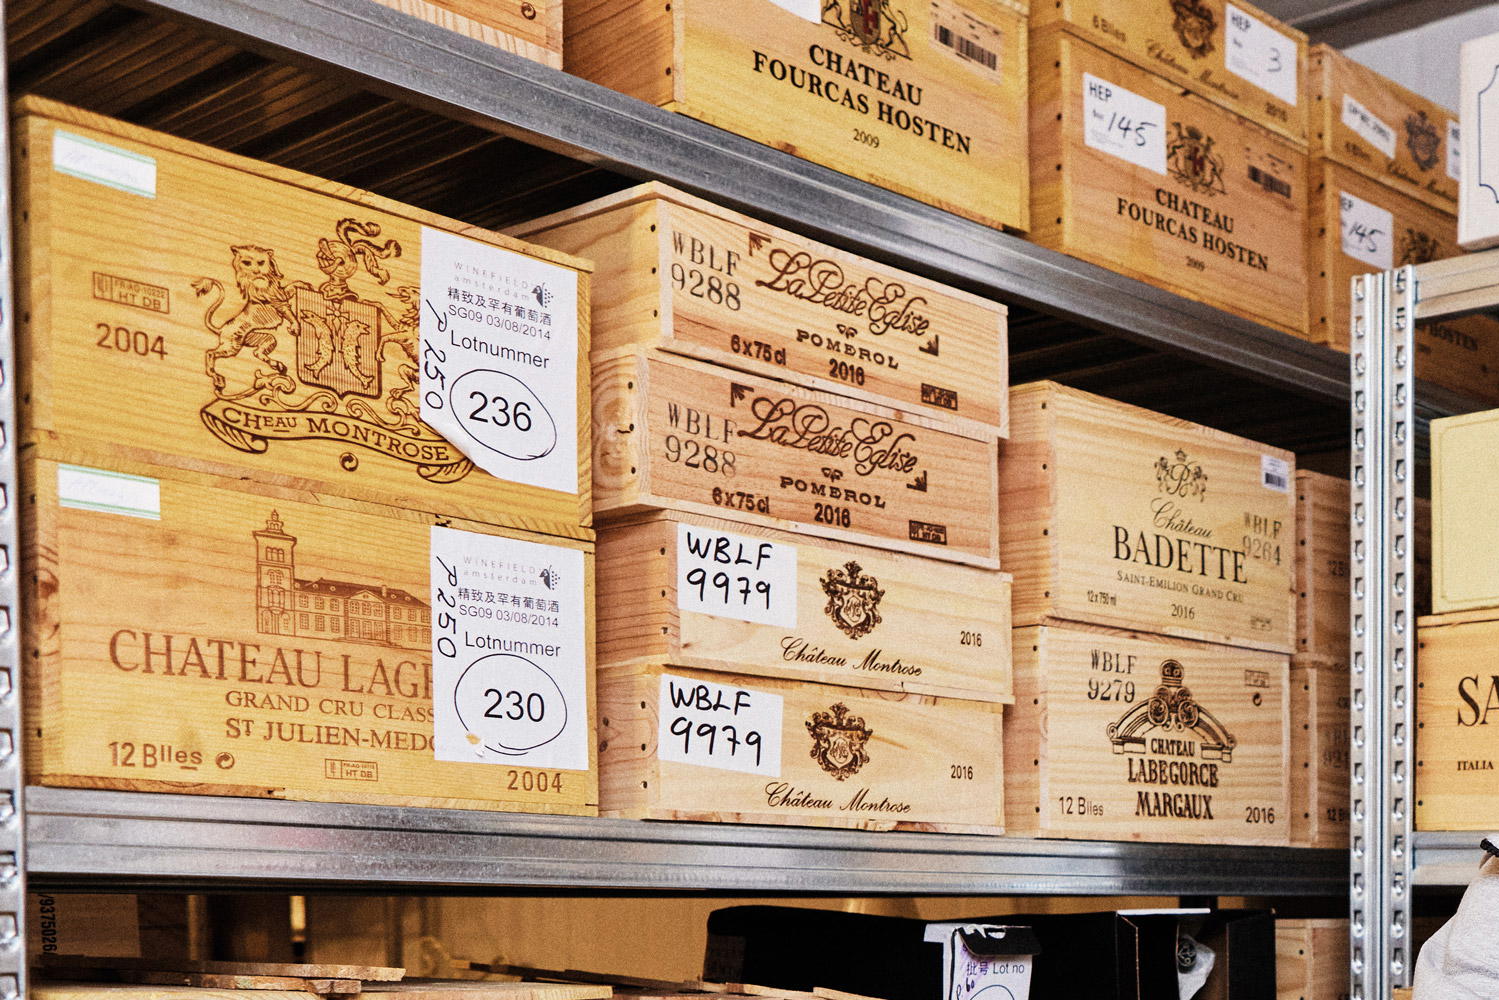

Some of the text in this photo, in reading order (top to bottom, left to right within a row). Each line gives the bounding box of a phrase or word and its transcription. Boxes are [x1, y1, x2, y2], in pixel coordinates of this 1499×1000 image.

[809, 43, 923, 107] CHATEAU
[752, 49, 972, 155] FOURCAS HOSTEN
[1089, 82, 1113, 104] HEP
[853, 128, 880, 149] 2009
[1107, 111, 1158, 148] 145
[1155, 188, 1235, 234] CHATEAU
[1116, 197, 1270, 272] FOURCAS HOSTEN
[672, 231, 742, 277] WBLF
[671, 262, 743, 312] 9288
[448, 304, 551, 342] SG09 03/08/2014
[96, 323, 168, 361] 2004
[450, 329, 550, 369] Lotnummer
[795, 328, 899, 370] POMEROL
[829, 359, 866, 386] 2016
[469, 391, 533, 432] 236
[668, 401, 738, 439] WBLF
[306, 416, 450, 462] MONTROSE
[664, 434, 738, 478] 9288
[779, 475, 887, 509] POMEROL
[814, 503, 851, 528] 2016
[1151, 497, 1213, 538] Château
[687, 530, 773, 571] WBLF
[1113, 524, 1248, 585] BADETTE
[686, 568, 771, 610] 9979
[459, 604, 560, 629] SG09 03/08/2014
[1171, 603, 1196, 620] 2016
[464, 631, 562, 658] Lotnummer
[780, 635, 923, 676] Château Montrose
[960, 631, 983, 648] 2016
[109, 628, 323, 688] CHATEAU
[1090, 648, 1138, 675] WBLF
[225, 690, 364, 718] GRAND CRU
[483, 687, 546, 722] 230
[669, 681, 752, 712] WBLF
[1087, 678, 1137, 704] 9279
[109, 741, 136, 768] 12
[669, 716, 763, 767] 9979
[1151, 736, 1196, 757] CHATEAU
[507, 769, 564, 795] 2004
[951, 764, 974, 780] 2016
[1127, 757, 1219, 788] LABEGORCE
[1457, 759, 1495, 773] ITALIA
[764, 782, 912, 815] Château Montrose
[1059, 796, 1074, 816] 12
[1135, 791, 1214, 820] MARGAUX
[1245, 806, 1276, 825] 2016
[966, 961, 1025, 976] 批号 Lot no
